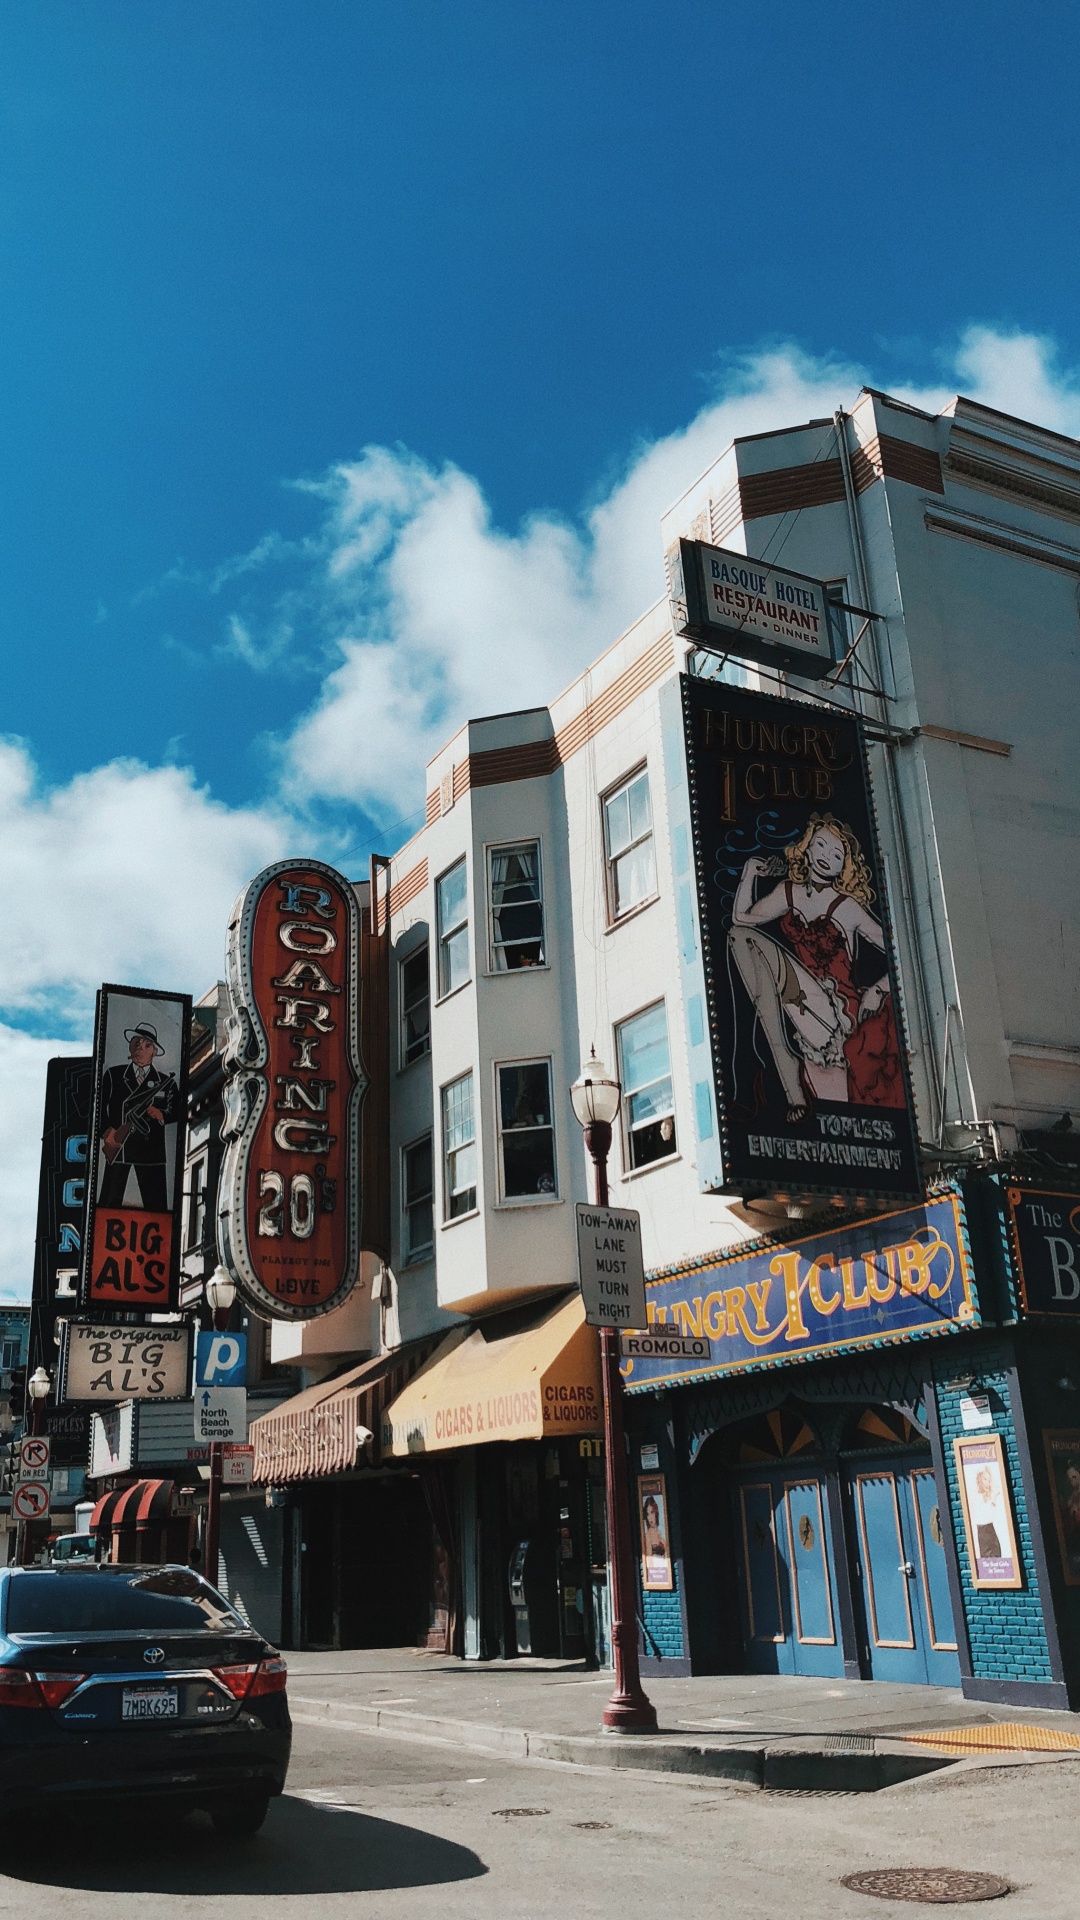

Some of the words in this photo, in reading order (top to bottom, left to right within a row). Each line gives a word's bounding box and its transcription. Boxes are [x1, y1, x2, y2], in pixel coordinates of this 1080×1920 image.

[710, 559, 767, 595] BASQUE
[774, 580, 819, 612] HOTEL
[712, 583, 820, 633] RESTAURANT
[716, 606, 757, 626] LUNCH
[773, 625, 819, 646] DINNER
[702, 708, 855, 771] HUNGRY
[744, 763, 835, 804] CLUB
[273, 880, 341, 1154] ROARING
[816, 1112, 896, 1142] TOPLESS
[747, 1134, 903, 1171] ENTERTAINMENT
[579, 1213, 638, 1233] TOW-AWAY
[1025, 1203, 1063, 1229] The
[106, 1217, 164, 1256] BIG
[594, 1236, 626, 1253] LANE
[95, 1253, 166, 1293] AL'S
[596, 1259, 627, 1274] MUST
[808, 1226, 955, 1317] CLUB
[275, 1277, 320, 1295] LOVE
[598, 1281, 629, 1296] TURN
[599, 1303, 631, 1318] RIGHT
[77, 1326, 109, 1339] The
[109, 1327, 182, 1344] Original
[89, 1342, 164, 1368] BIG
[628, 1338, 704, 1355] ROMOLO
[90, 1368, 166, 1393] AL'S
[545, 1385, 594, 1402] CIGARS
[200, 1408, 227, 1418] North
[200, 1418, 230, 1427] Beach
[435, 1403, 473, 1439] CIGARS
[476, 1406, 484, 1432] &
[487, 1390, 538, 1428] LIQUORS
[543, 1406, 551, 1421] &
[553, 1405, 599, 1422] LIQUORS
[200, 1427, 234, 1438] Garage
[22, 1469, 32, 1477] ON
[32, 1469, 46, 1477] RED
[124, 1697, 176, 1716] 7MBK695
